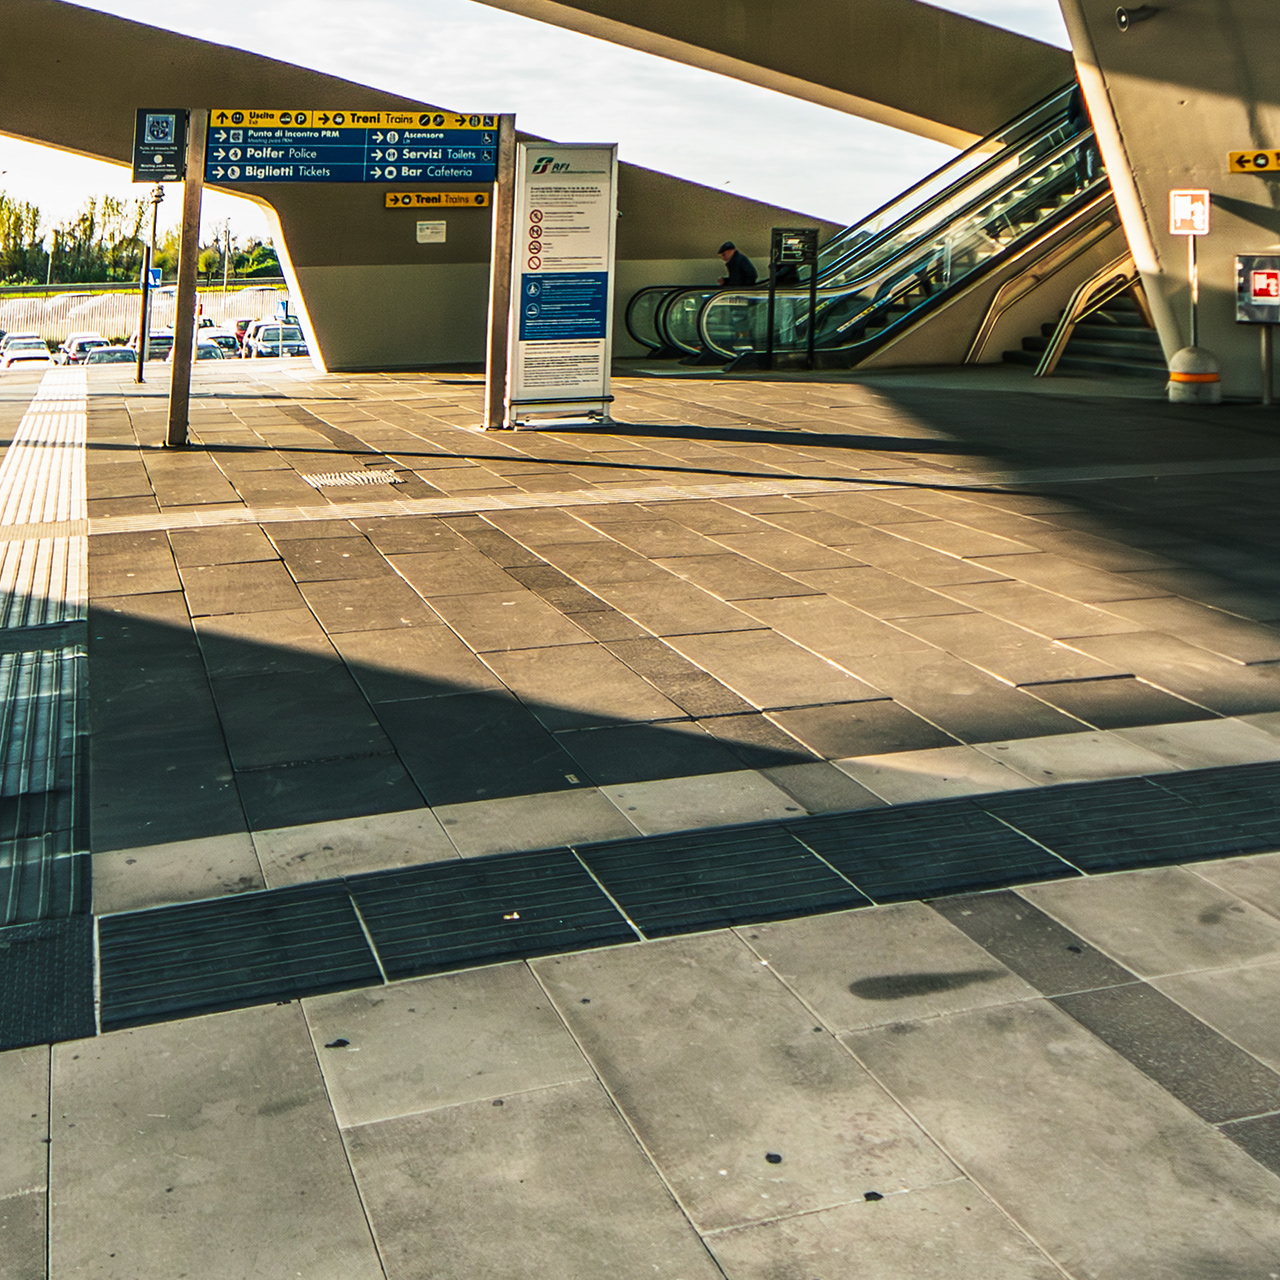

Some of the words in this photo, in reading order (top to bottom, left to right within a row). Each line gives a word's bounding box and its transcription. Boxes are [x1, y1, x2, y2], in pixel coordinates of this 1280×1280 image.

[249, 111, 274, 120] Uscita
[350, 113, 380, 123] Treni
[385, 113, 413, 124] Trains
[248, 129, 272, 138] Punto
[274, 129, 283, 137] di
[321, 130, 340, 138] PRM
[403, 131, 444, 139] Ascensore
[246, 147, 285, 159] Polfer
[288, 148, 317, 159] Police
[402, 148, 442, 159] Servizi
[447, 149, 476, 160] Toilets
[401, 166, 422, 177] Bar
[427, 166, 473, 177] Cafeteria
[551, 163, 570, 171] RFI
[245, 166, 293, 179] Biglietti
[298, 166, 331, 177] Tickets
[415, 194, 441, 204] Treni
[445, 194, 469, 204] Trains
